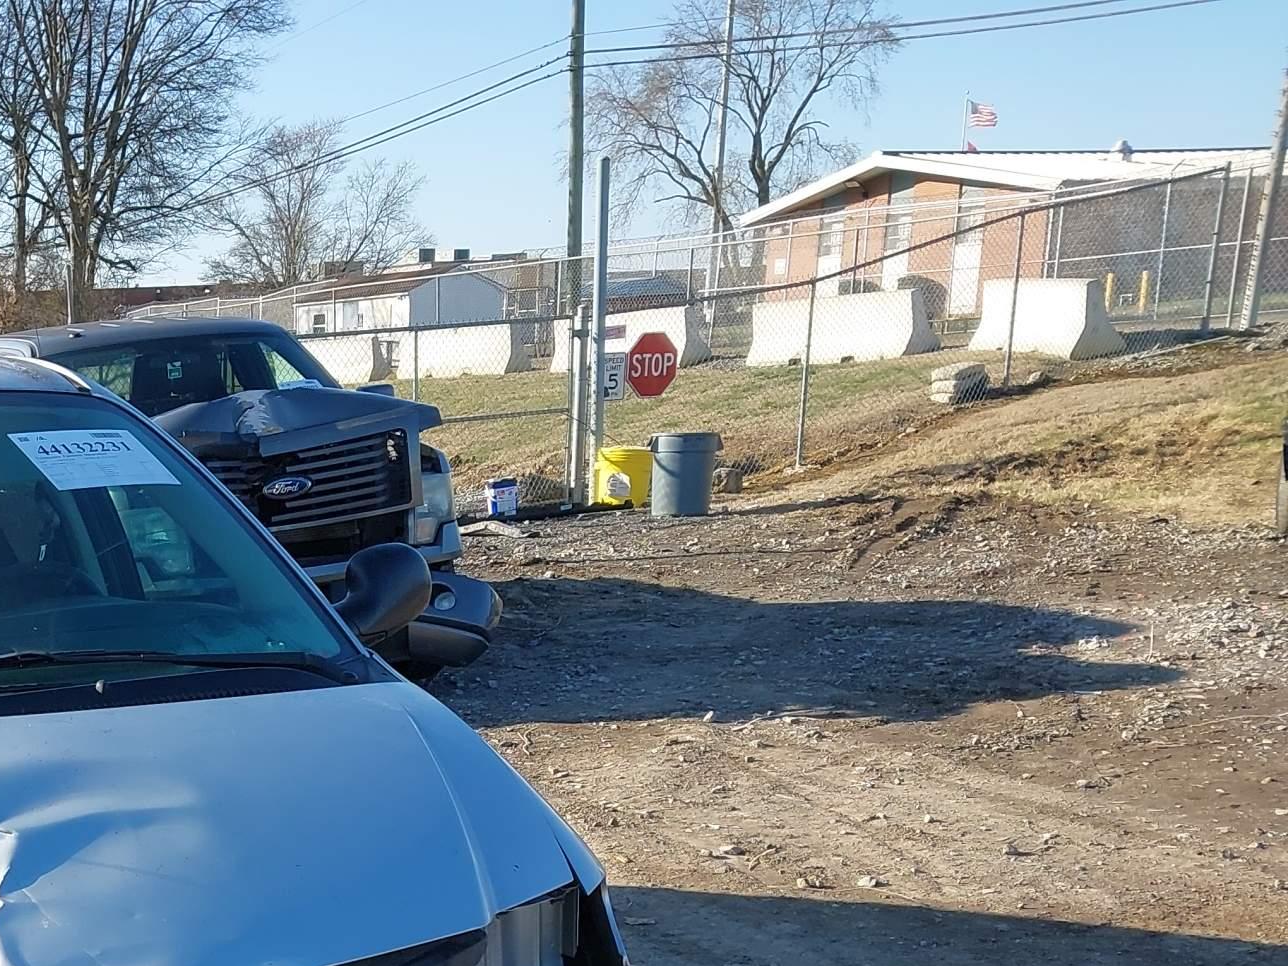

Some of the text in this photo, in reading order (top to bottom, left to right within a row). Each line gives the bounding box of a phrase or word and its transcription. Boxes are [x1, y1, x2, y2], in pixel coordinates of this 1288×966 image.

[632, 352, 675, 378] STOP
[608, 373, 618, 390] 5
[37, 441, 131, 456] 44132231
[267, 480, 300, 495] Ford
